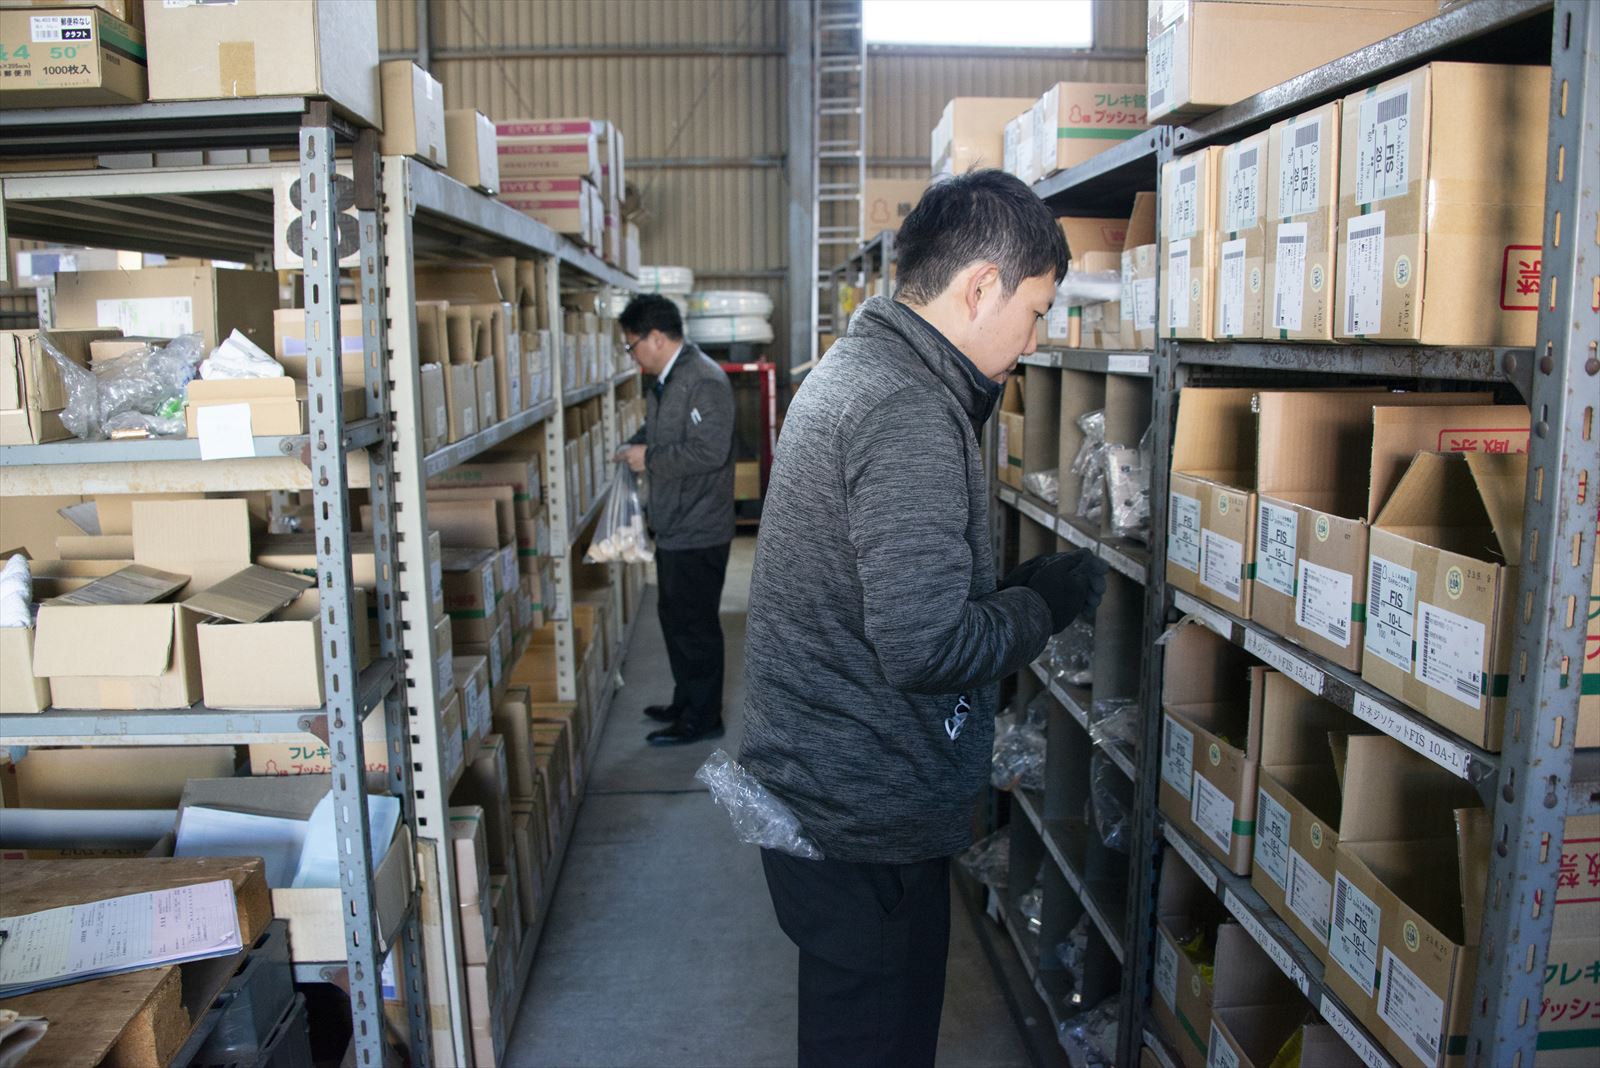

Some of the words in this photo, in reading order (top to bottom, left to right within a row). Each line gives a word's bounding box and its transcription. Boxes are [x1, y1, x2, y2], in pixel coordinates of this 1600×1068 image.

[50, 46, 77, 59] 50
[42, 65, 91, 76] 1000枚入
[1375, 145, 1383, 178] 20-L
[1386, 143, 1395, 174] FIS
[1276, 529, 1287, 544] FIS
[1389, 589, 1403, 608] FIS
[1388, 612, 1403, 629] 10-L
[1295, 661, 1317, 687] 15A-L
[1429, 745, 1459, 768] 10A-L
[1354, 912, 1368, 934] FIS
[1353, 932, 1367, 953] 10-L
